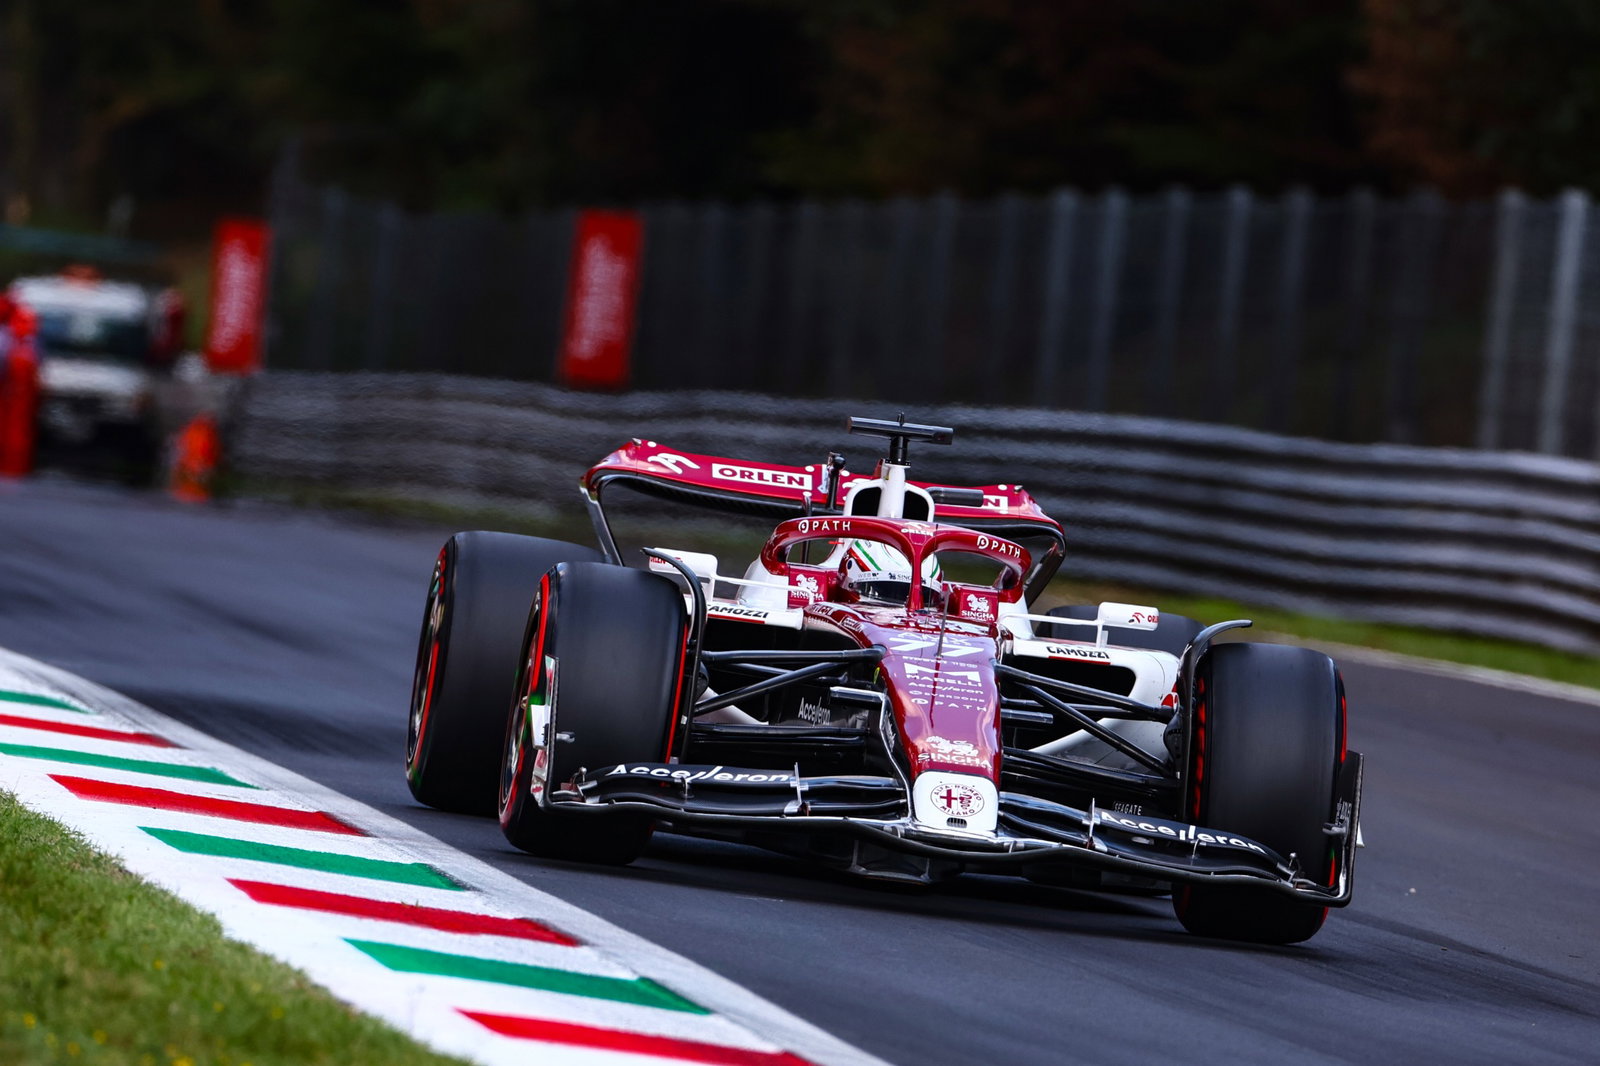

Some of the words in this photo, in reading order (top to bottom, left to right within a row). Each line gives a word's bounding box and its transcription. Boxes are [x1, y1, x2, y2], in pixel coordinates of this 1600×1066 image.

[718, 468, 805, 487] ORLEN
[812, 520, 851, 531] PATH
[901, 528, 934, 537] ORLEN
[991, 541, 1021, 558] PATH
[707, 604, 769, 618] AMOZZI
[961, 610, 995, 619] SINGHA
[889, 638, 984, 657] 77
[1046, 646, 1110, 659] CAMOZZI
[906, 674, 982, 687] MARELLI
[935, 701, 987, 712] PATH
[917, 752, 993, 769] SINGHA
[605, 764, 789, 783] Accelleron
[954, 784, 982, 801] ROMEO
[940, 805, 975, 816] MILANO
[1101, 811, 1267, 855] Accelleron
